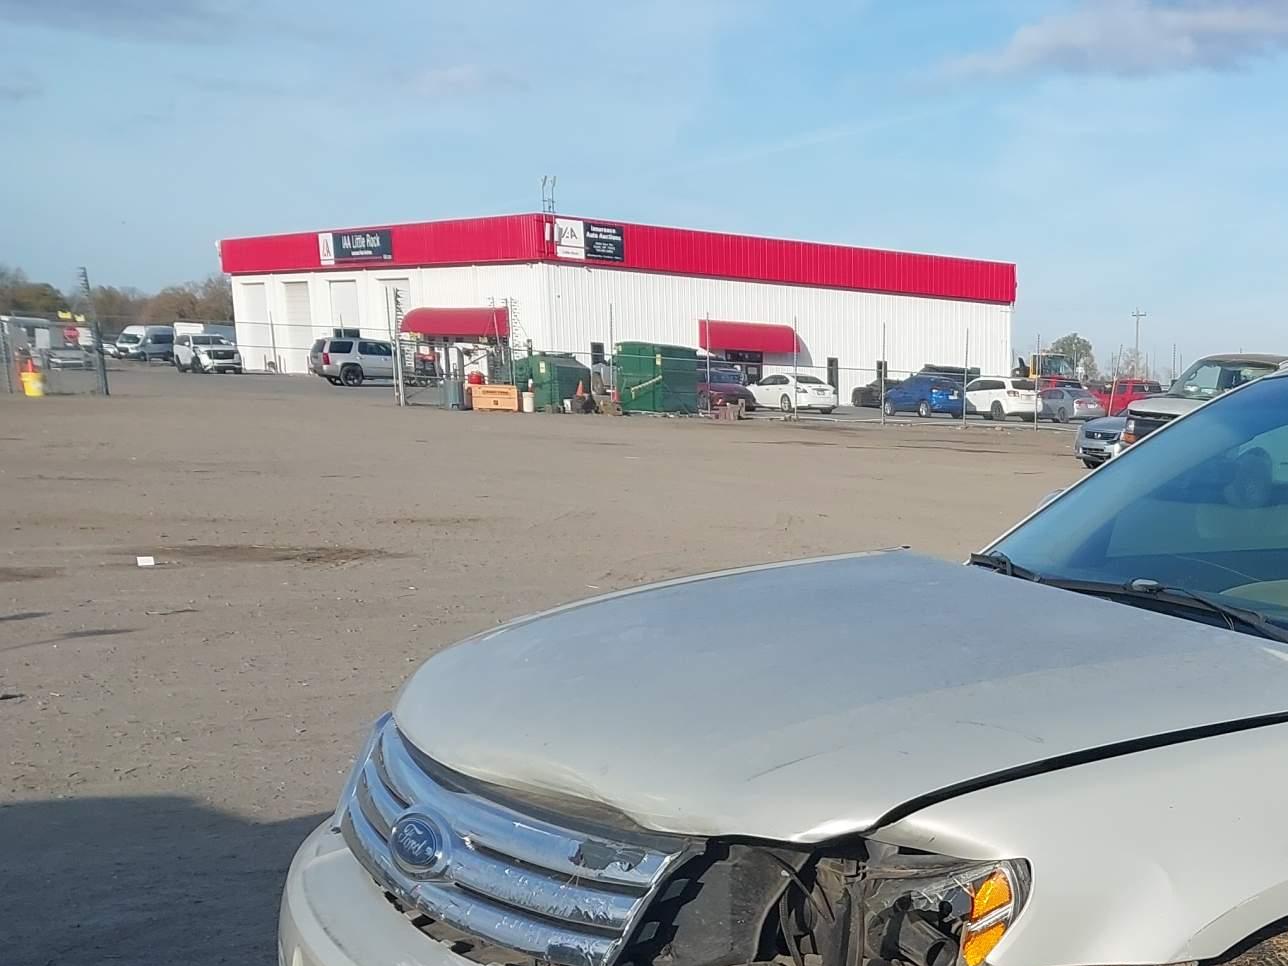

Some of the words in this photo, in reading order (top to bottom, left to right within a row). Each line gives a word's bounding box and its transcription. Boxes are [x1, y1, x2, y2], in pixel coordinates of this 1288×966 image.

[352, 235, 365, 248] Little
[367, 233, 380, 247] Rock
[398, 823, 426, 857] Ford
